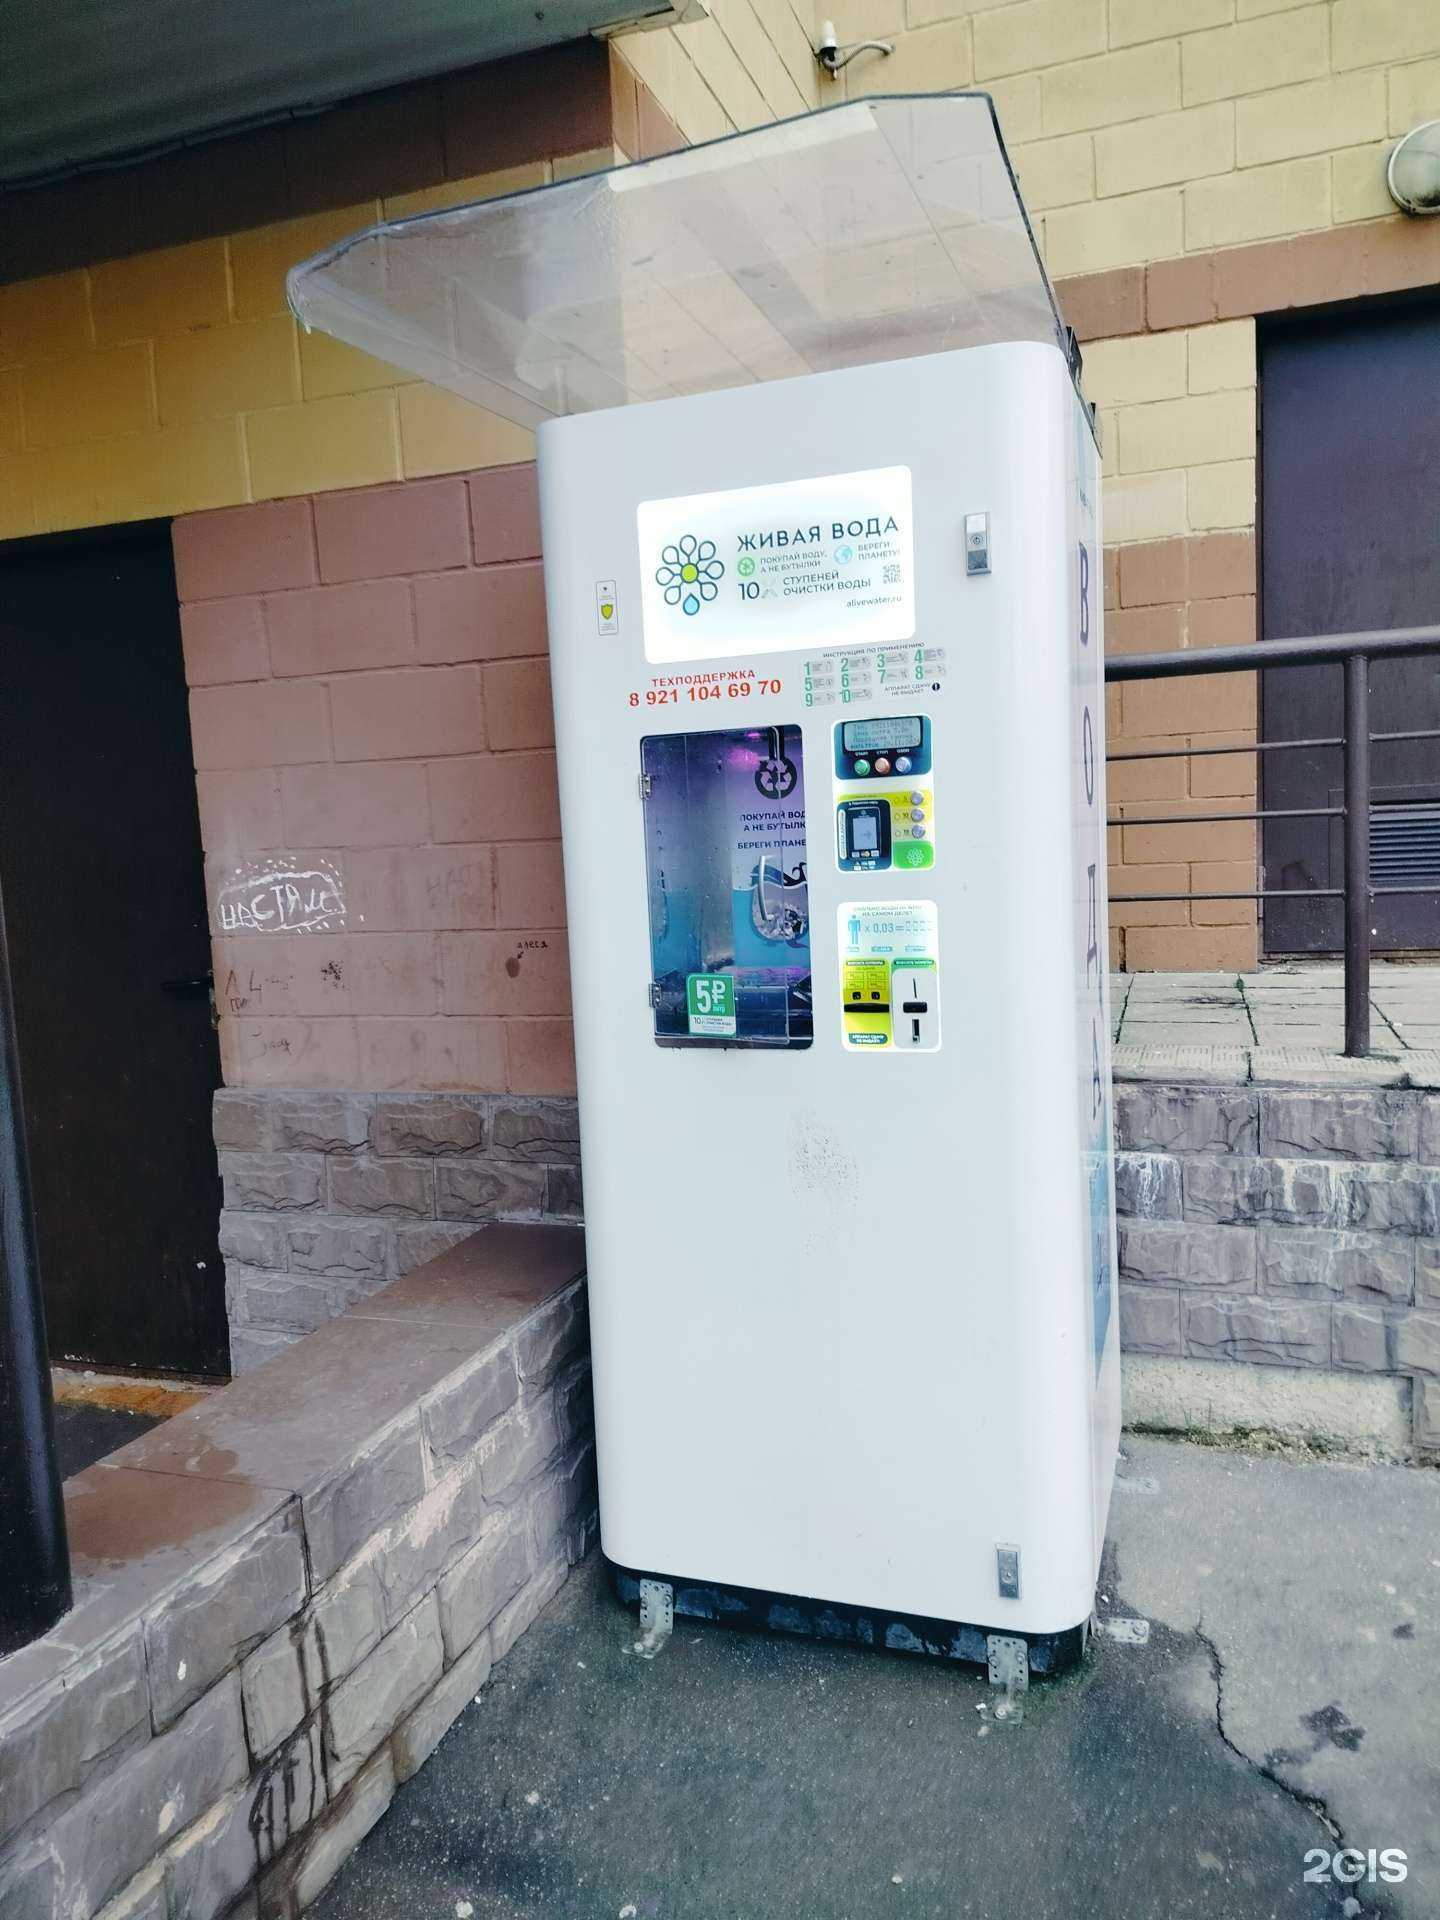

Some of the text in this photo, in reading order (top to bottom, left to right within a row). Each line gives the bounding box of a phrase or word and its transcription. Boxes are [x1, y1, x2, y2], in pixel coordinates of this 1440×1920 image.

[737, 516, 899, 552] ЖИВАЯ ВОДА
[858, 541, 890, 552] БЕРЕГИ
[760, 552, 800, 565] ПОКУПАЙ
[760, 560, 821, 574] А НЕ БУТЫЛКИ
[783, 571, 839, 586] СТУПЕНЕЙ
[738, 582, 760, 600] 10
[783, 578, 871, 596] ОЧИСТКИ ВОДЫ
[877, 654, 885, 668] 3
[914, 650, 923, 664] 4
[804, 662, 811, 676] 1
[841, 658, 849, 672] 2
[652, 669, 756, 688] ТЕХПОДДЕРЖКА
[878, 669, 886, 684] 7
[915, 666, 924, 680] 8
[805, 677, 813, 691] 5
[841, 674, 849, 688] 6
[629, 679, 782, 706] 8 921 104 69 70
[805, 693, 813, 707] 9
[740, 810, 785, 822] ПОКУПАЙ
[752, 824, 765, 832] НЕ
[737, 842, 772, 850] БЕРЕГИ
